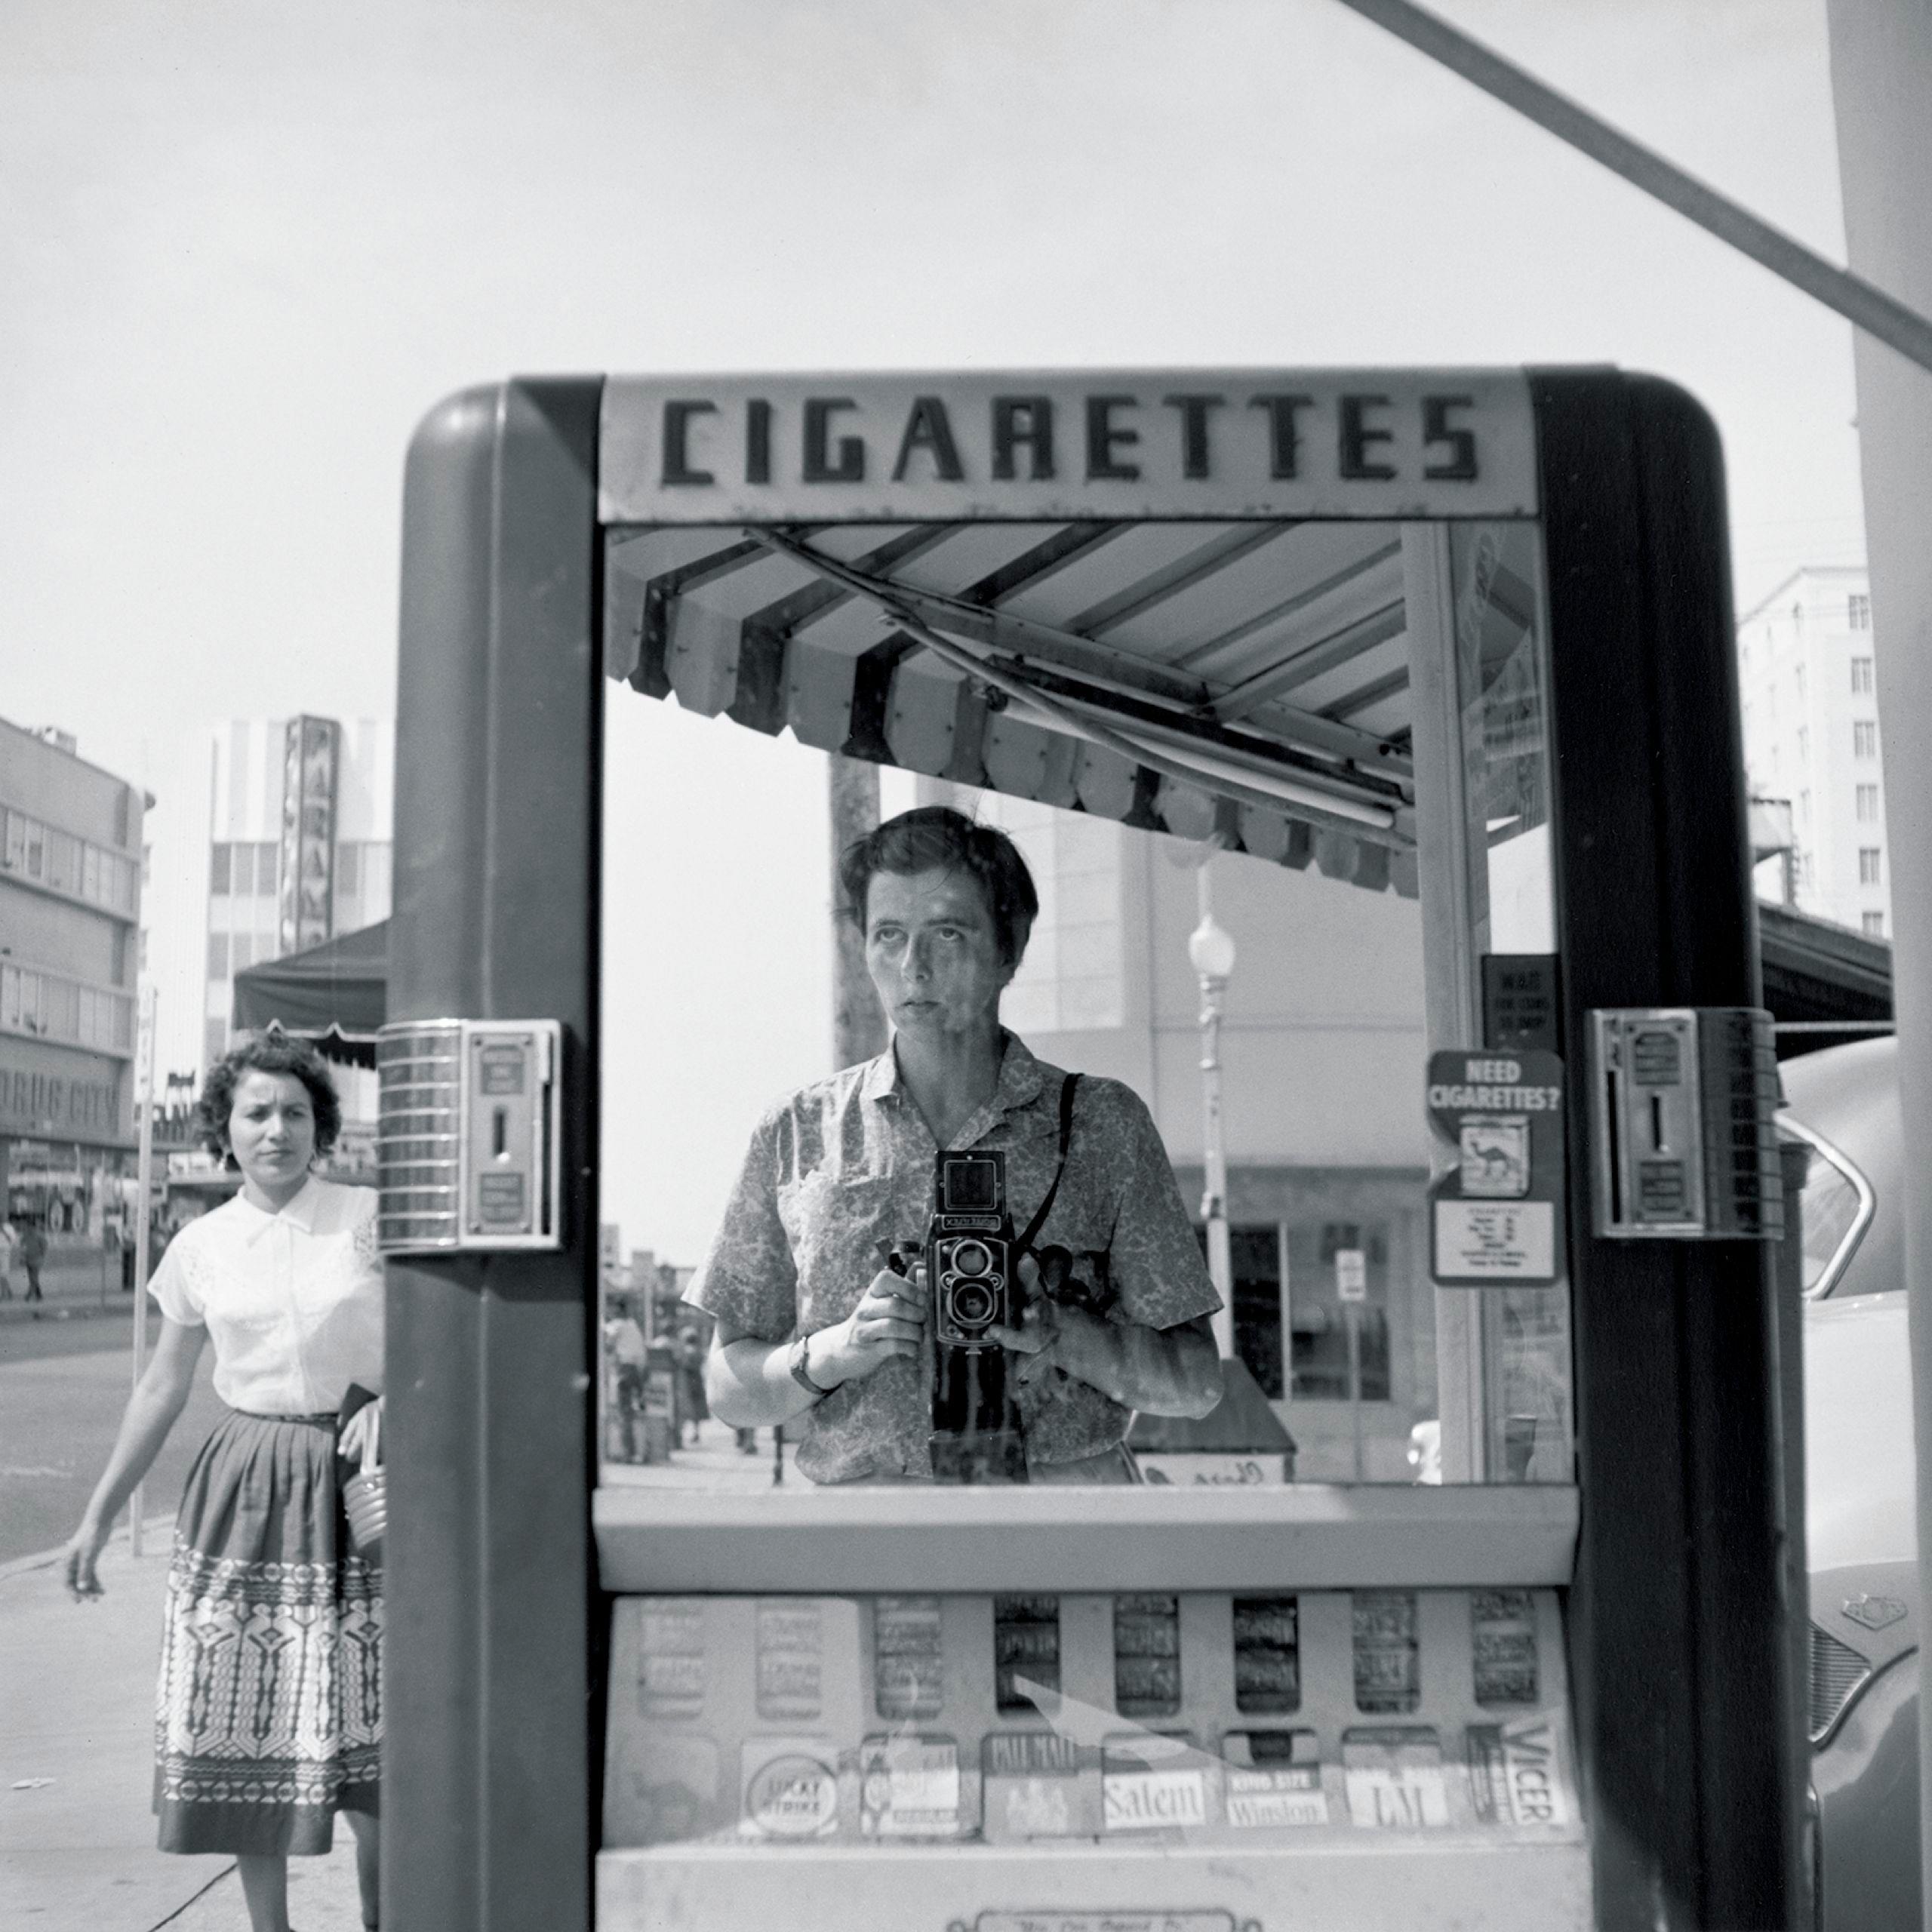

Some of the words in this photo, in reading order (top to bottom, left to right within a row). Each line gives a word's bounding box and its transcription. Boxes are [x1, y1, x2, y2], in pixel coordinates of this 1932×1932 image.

[661, 395, 1479, 486] CIGARETTES
[1465, 1060, 1521, 1083] NEED
[1429, 1085, 1561, 1111] CIGARETTES?
[992, 1737, 1027, 1768] PALL
[1033, 1737, 1075, 1769] MALL
[1232, 1773, 1272, 1792] KING
[1275, 1770, 1311, 1789] SIZE
[1105, 1781, 1199, 1820] Salem
[1232, 1799, 1318, 1823] Winston
